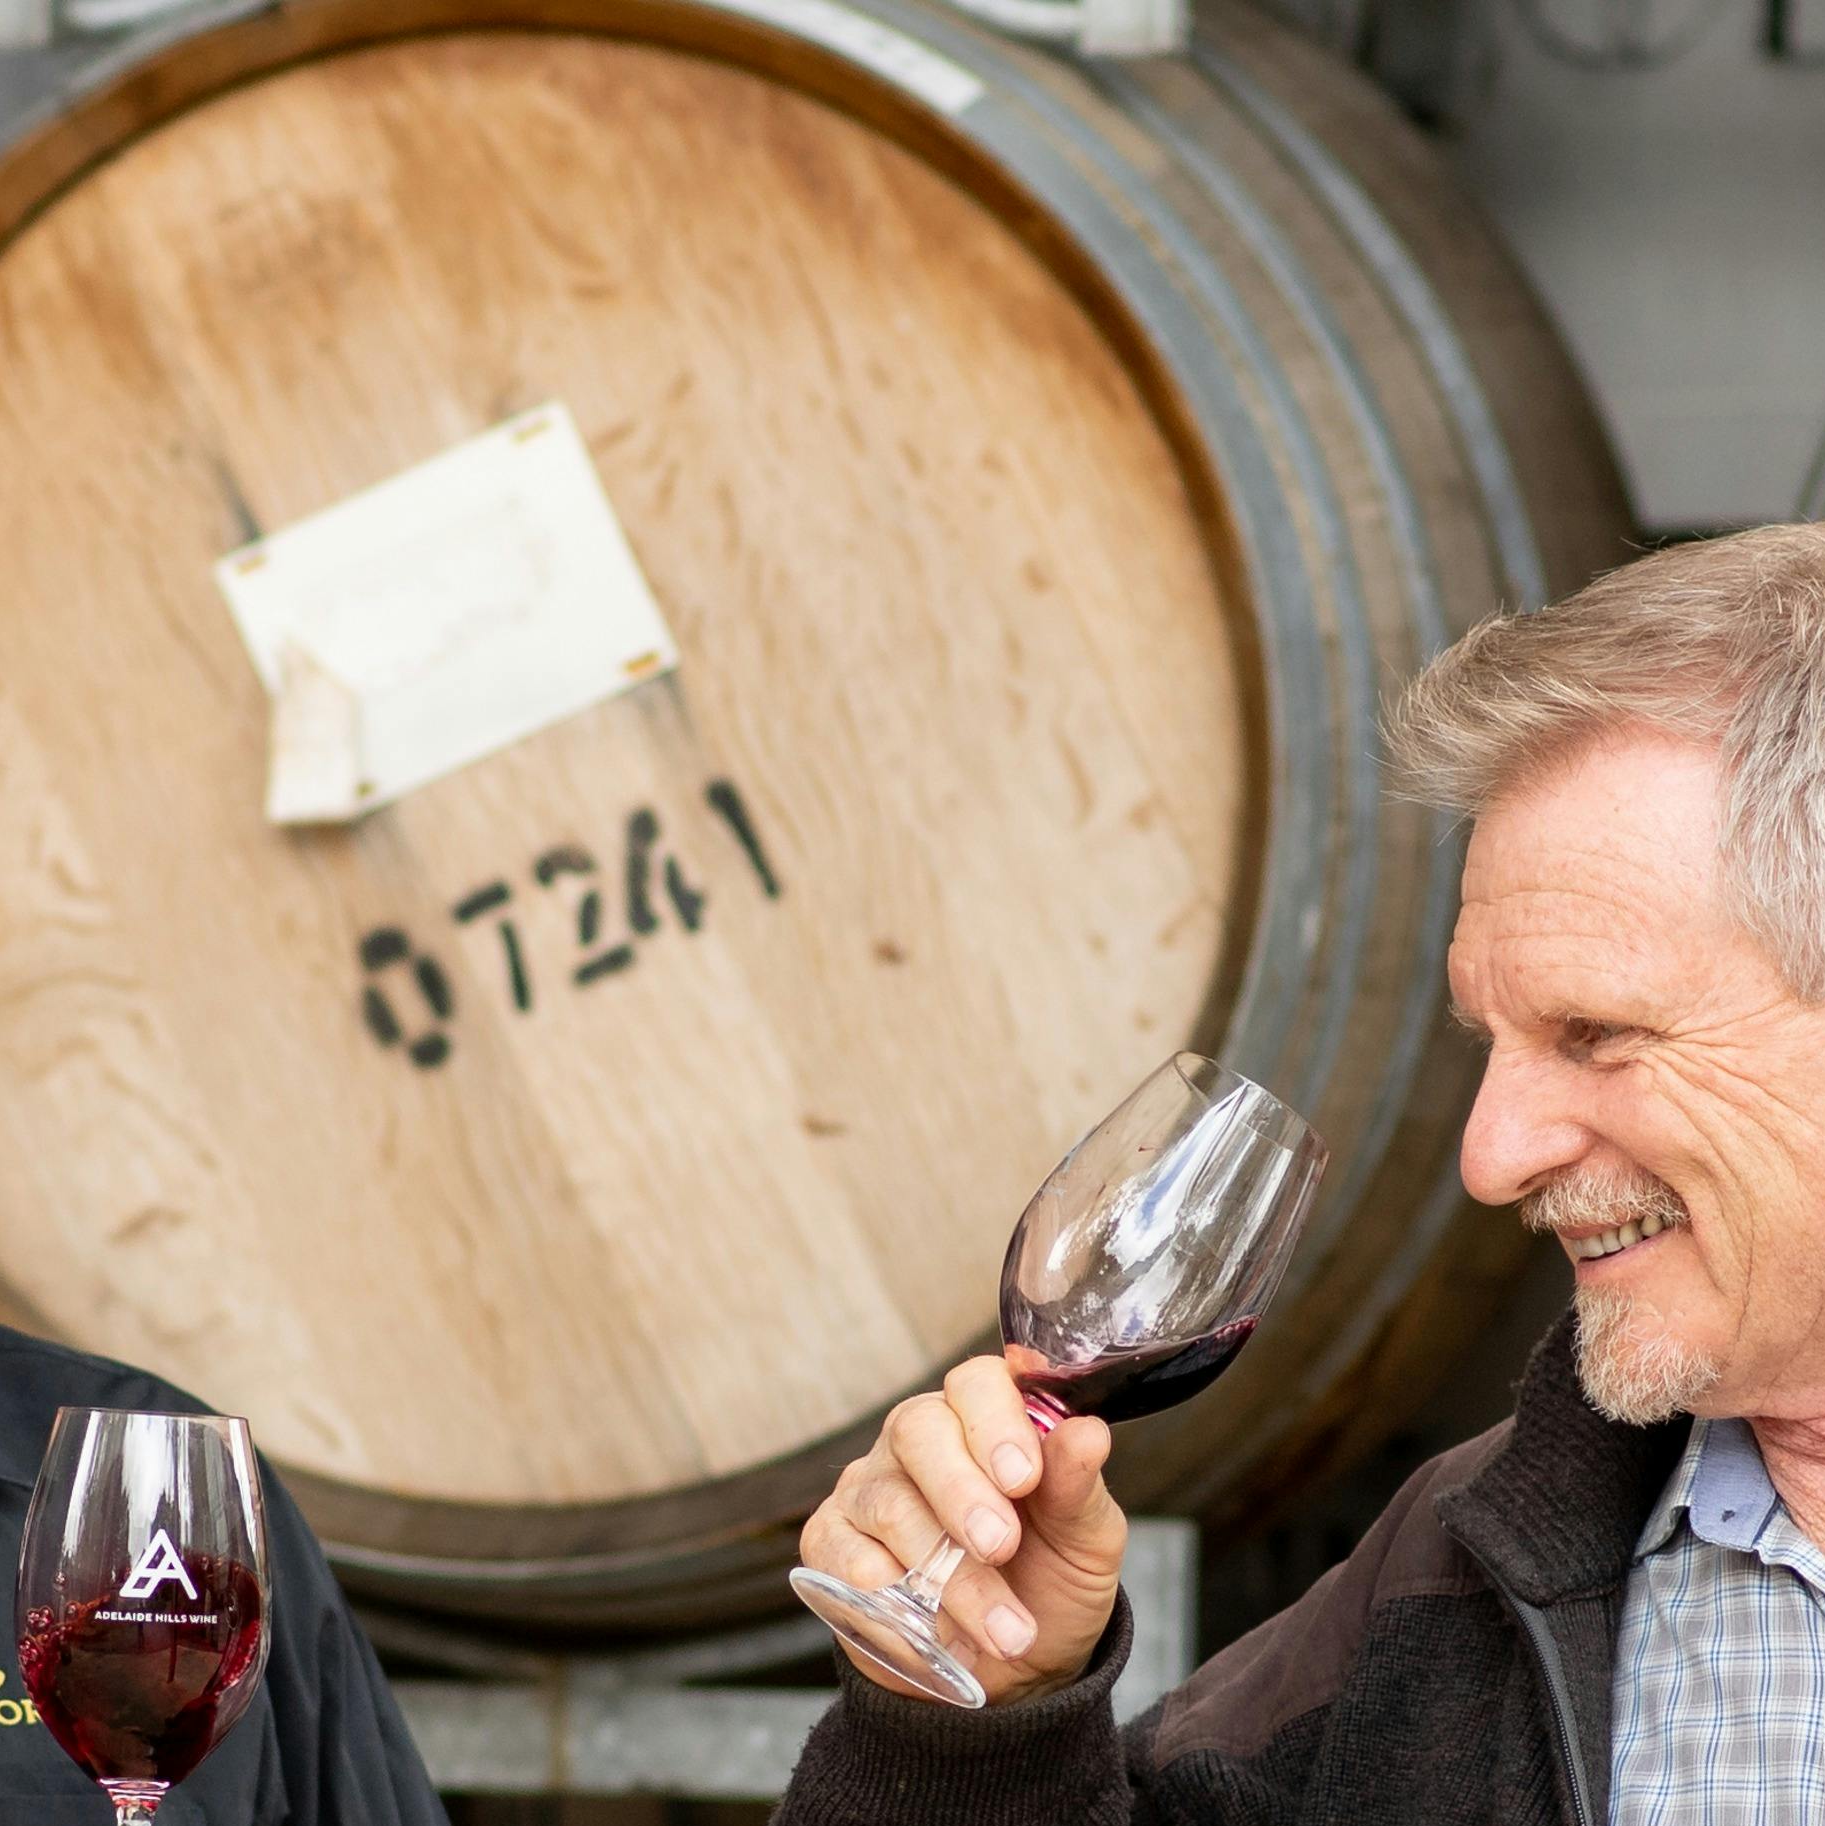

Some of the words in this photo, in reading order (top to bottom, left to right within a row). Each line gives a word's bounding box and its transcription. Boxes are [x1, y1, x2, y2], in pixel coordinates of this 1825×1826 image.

[360, 778, 783, 1070] 07241
[94, 1611, 152, 1622] ADELAIDE
[155, 1613, 187, 1623] HILLS
[189, 1615, 218, 1624] WINE
